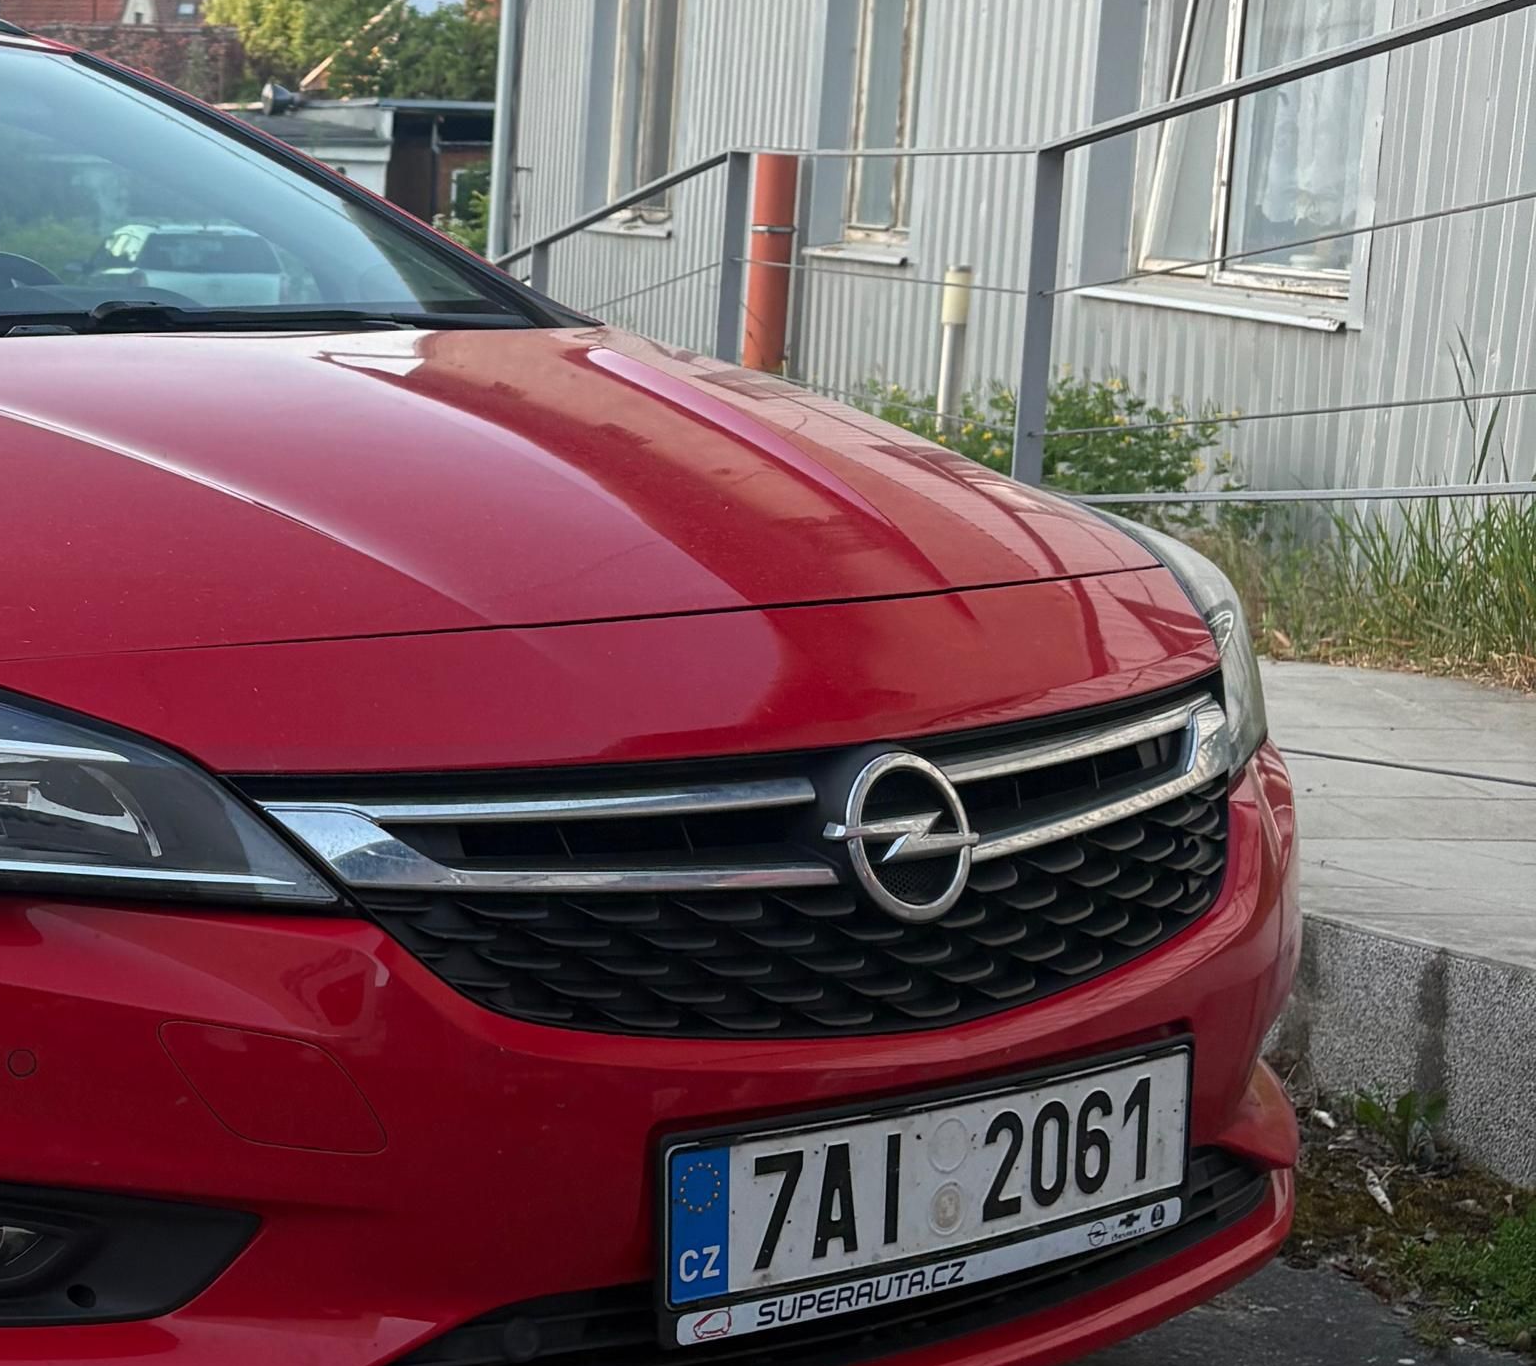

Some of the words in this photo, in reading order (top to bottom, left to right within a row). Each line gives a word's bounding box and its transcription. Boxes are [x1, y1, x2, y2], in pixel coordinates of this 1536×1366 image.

[752, 1133, 902, 1272] 7AI
[982, 1076, 1152, 1223] 2061
[679, 1244, 721, 1283] CZ
[756, 1260, 967, 1327] SUPERAUTA.CZ
